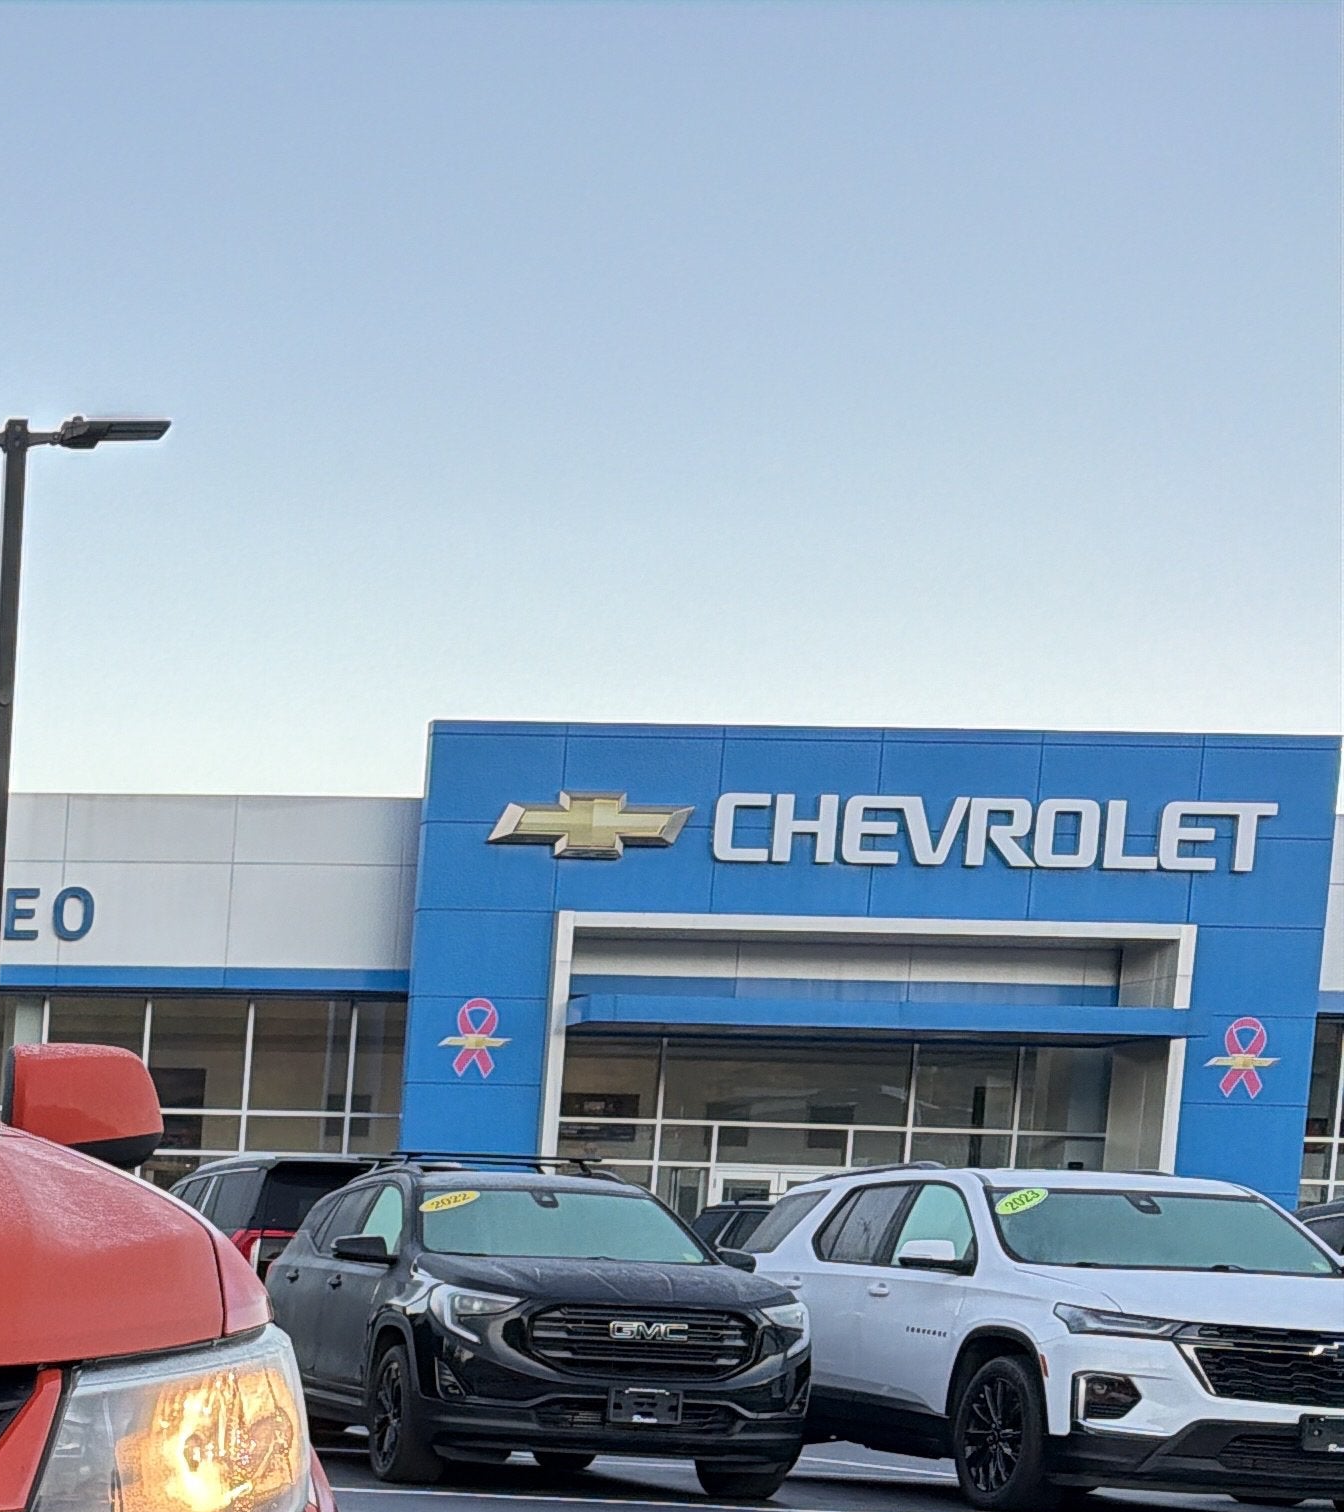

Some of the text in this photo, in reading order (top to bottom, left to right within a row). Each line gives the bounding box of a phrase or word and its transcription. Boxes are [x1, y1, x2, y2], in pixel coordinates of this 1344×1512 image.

[713, 791, 1279, 872] CHEVROLET
[430, 1193, 470, 1209] 2022
[1004, 1190, 1040, 1211] 2023
[609, 1320, 689, 1341] GMC
